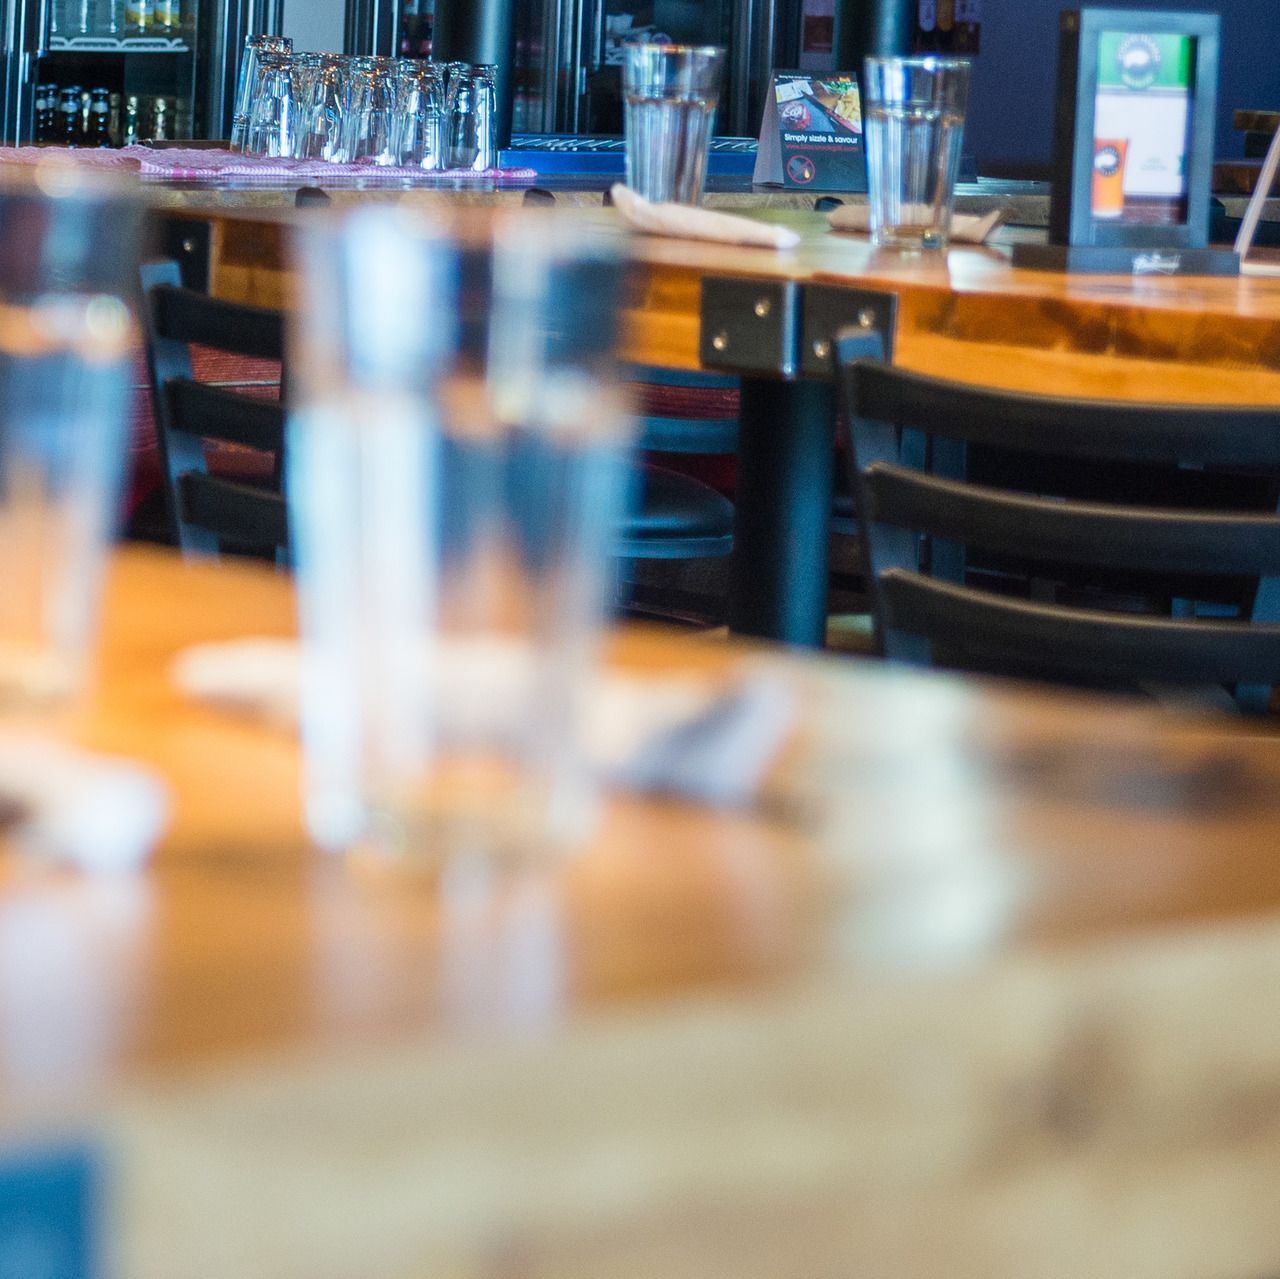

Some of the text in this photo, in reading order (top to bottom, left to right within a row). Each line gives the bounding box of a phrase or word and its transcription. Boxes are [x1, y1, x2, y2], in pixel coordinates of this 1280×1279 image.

[784, 132, 808, 144] Simply
[809, 134, 827, 143] sizzle
[834, 135, 858, 145] savour
